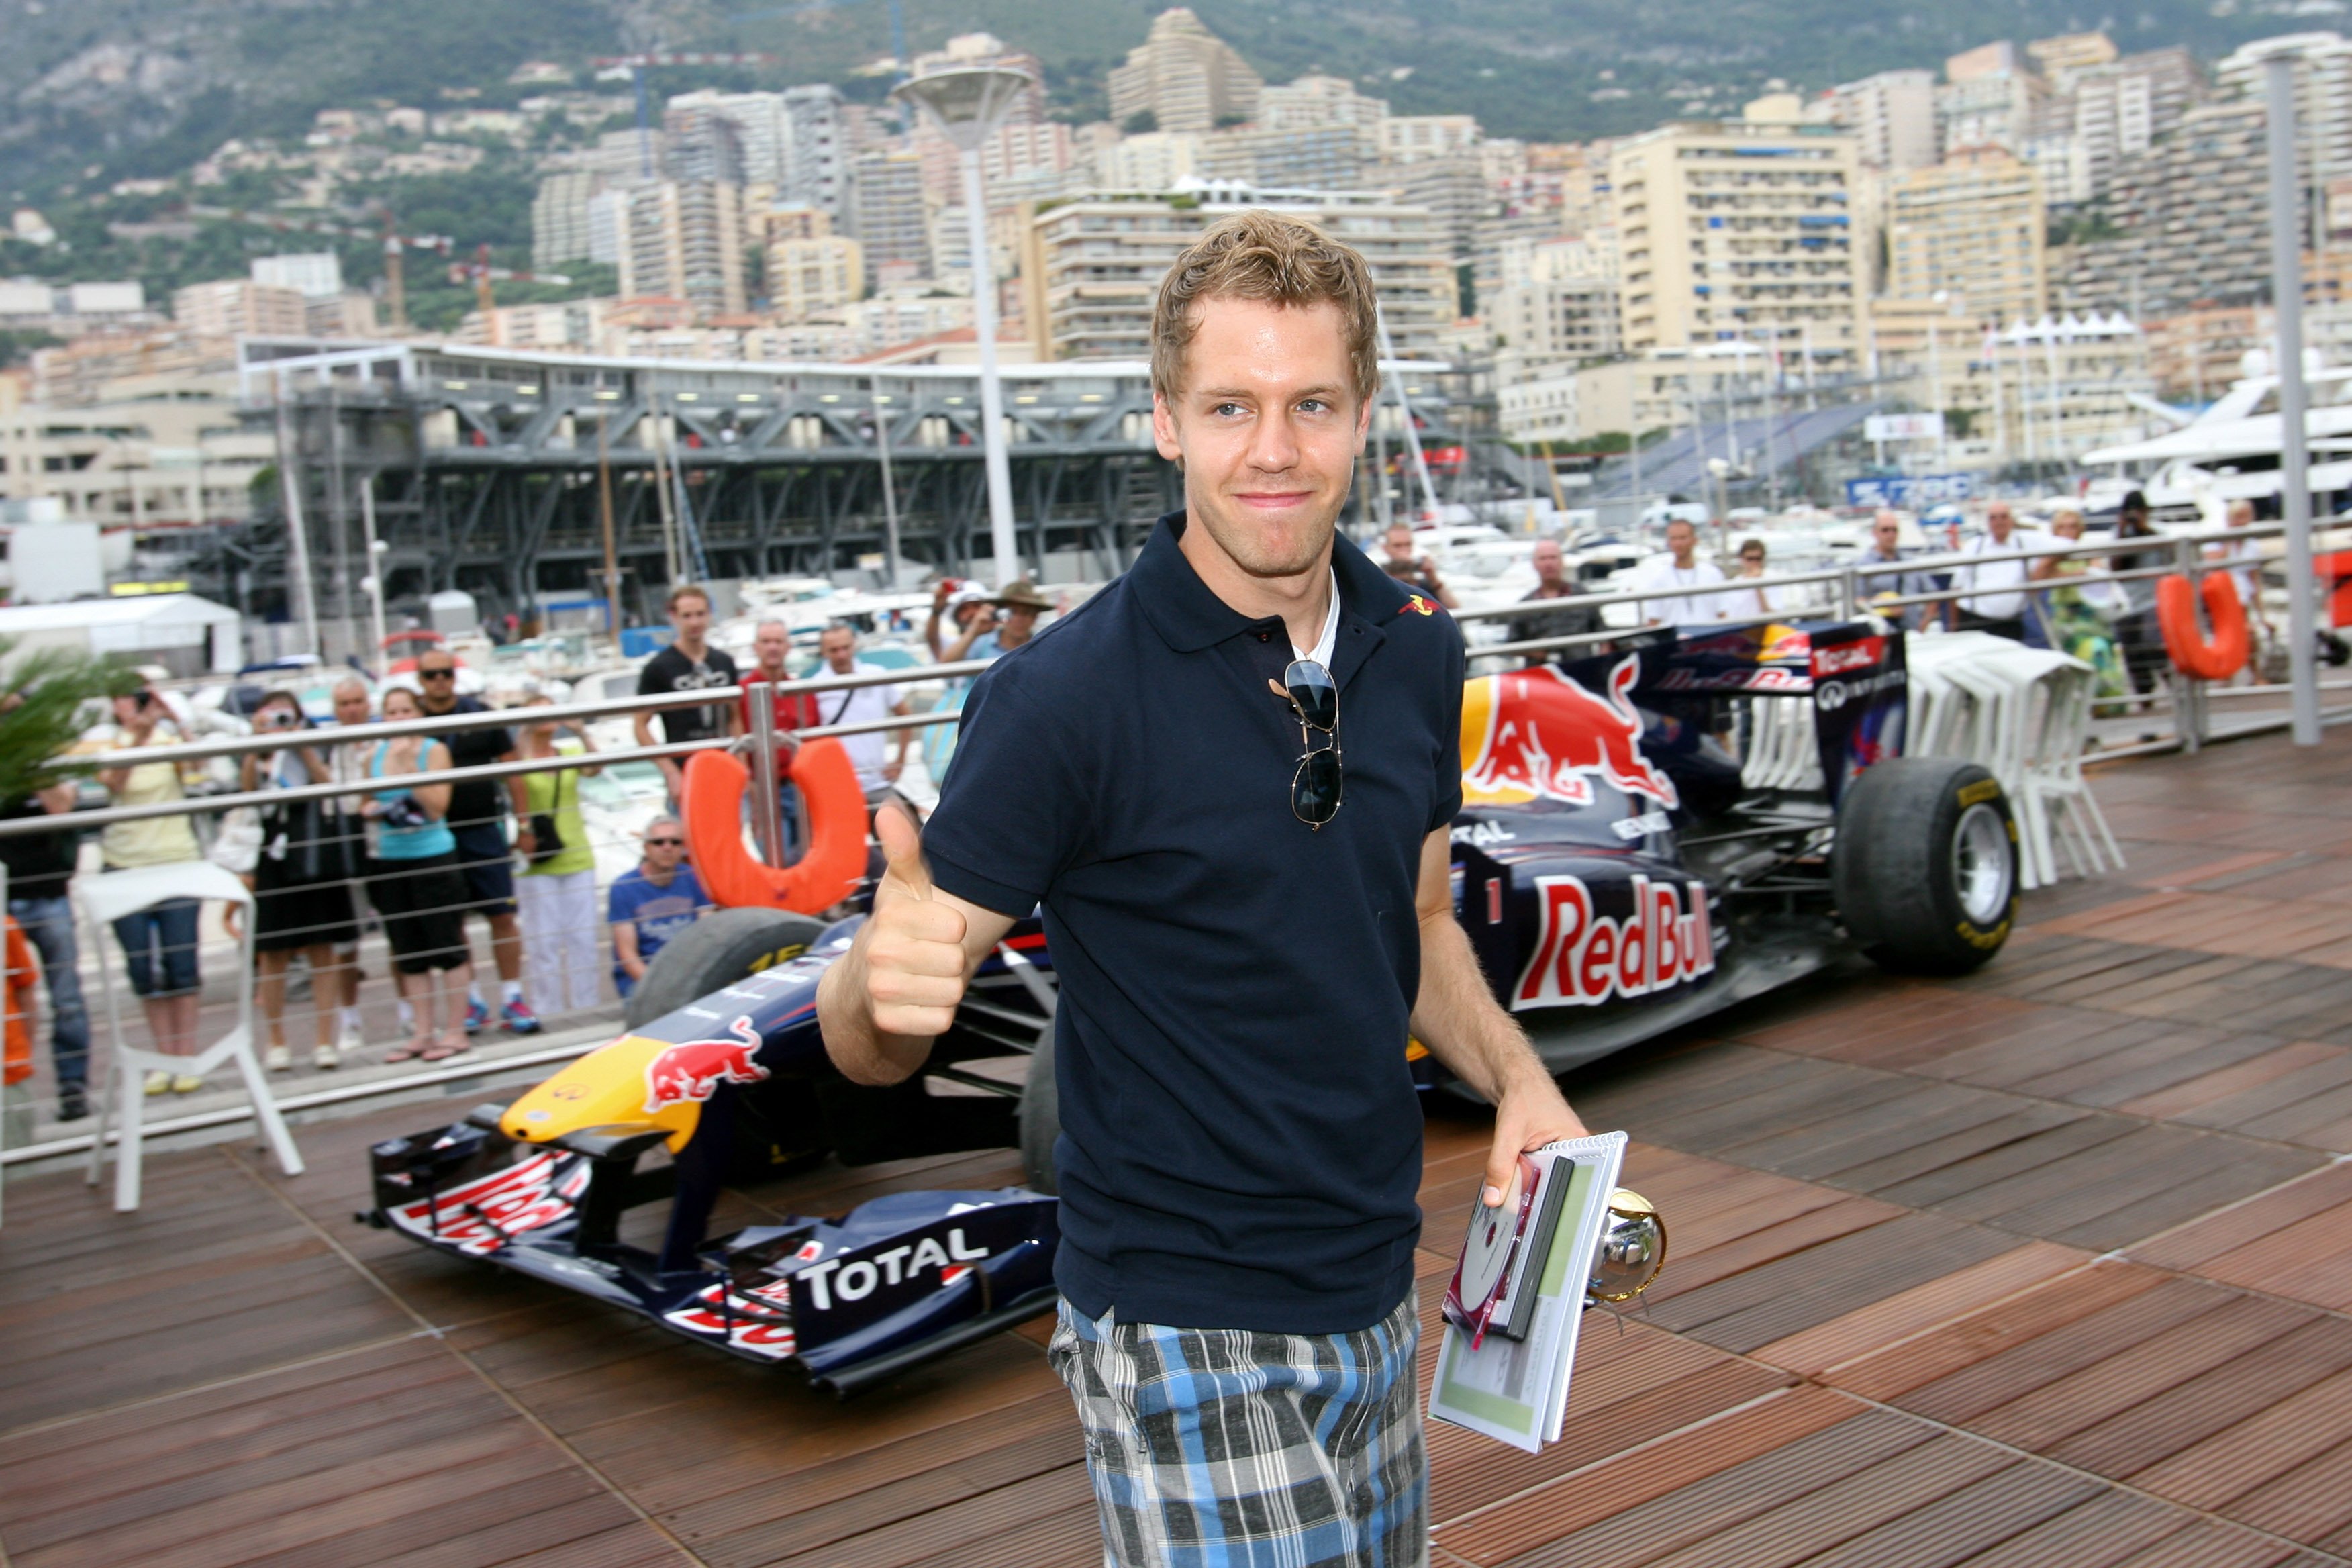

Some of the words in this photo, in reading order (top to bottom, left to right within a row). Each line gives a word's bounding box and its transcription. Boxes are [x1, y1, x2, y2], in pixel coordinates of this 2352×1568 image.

[1512, 874, 1650, 1011] Red
[1649, 881, 1715, 991] Bull
[796, 1228, 989, 1311] TOTAL
